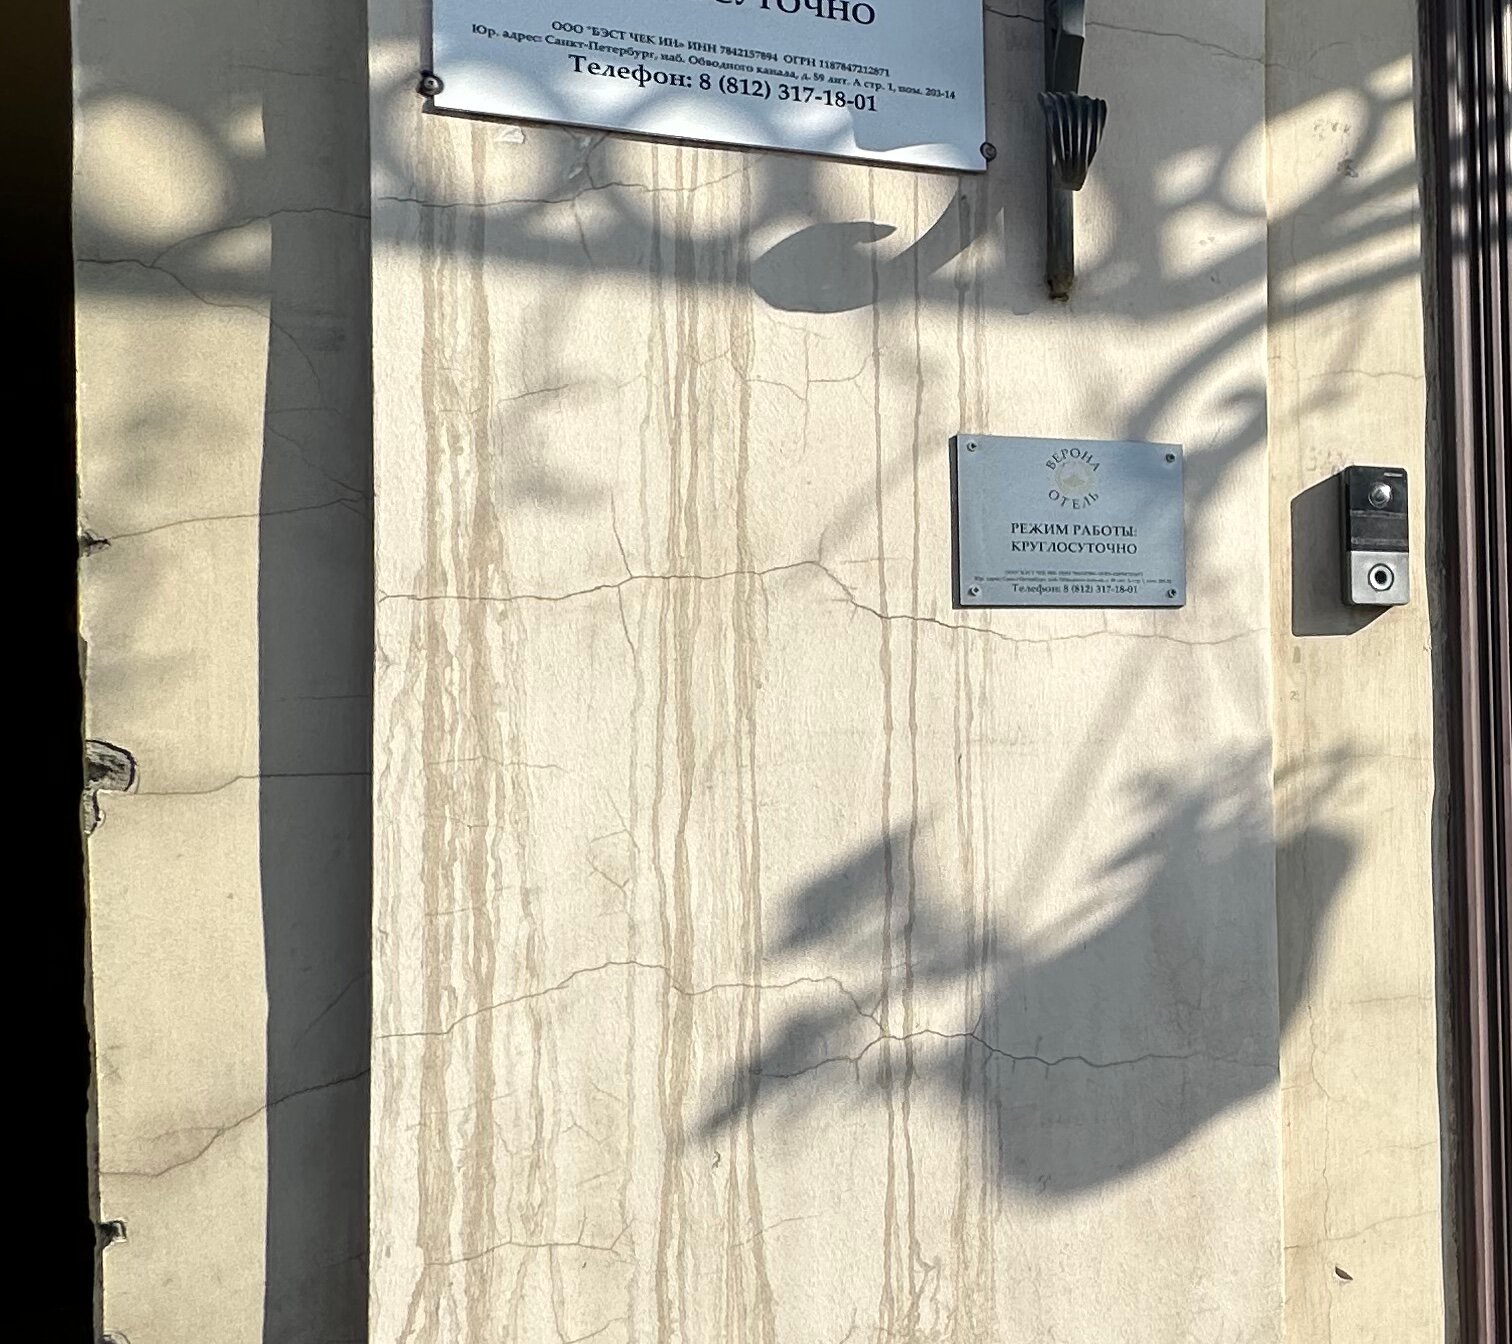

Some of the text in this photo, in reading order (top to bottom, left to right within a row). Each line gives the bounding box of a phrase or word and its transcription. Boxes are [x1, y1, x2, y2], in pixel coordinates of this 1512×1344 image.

[551, 20, 584, 34] ООО
[629, 32, 656, 45] ЧЕК
[687, 40, 717, 53] ИНН
[783, 53, 817, 67] ОГРН
[471, 23, 499, 39] Юр.
[688, 55, 754, 72] Обводного
[853, 78, 862, 87] А
[863, 81, 886, 92] стр.
[567, 53, 878, 112] Телефон: 8 (812) 317-18-01
[1045, 447, 1101, 471] ВЕРОНА
[1048, 489, 1099, 509] ОТЕЛЬ
[1010, 522, 1137, 537] РЕЖИМ РАБОТЫ:
[1011, 541, 1138, 555] КРУГЛОСУТОЧНО
[1012, 584, 1138, 595] Телефон: 8 (812) 317-18-01
